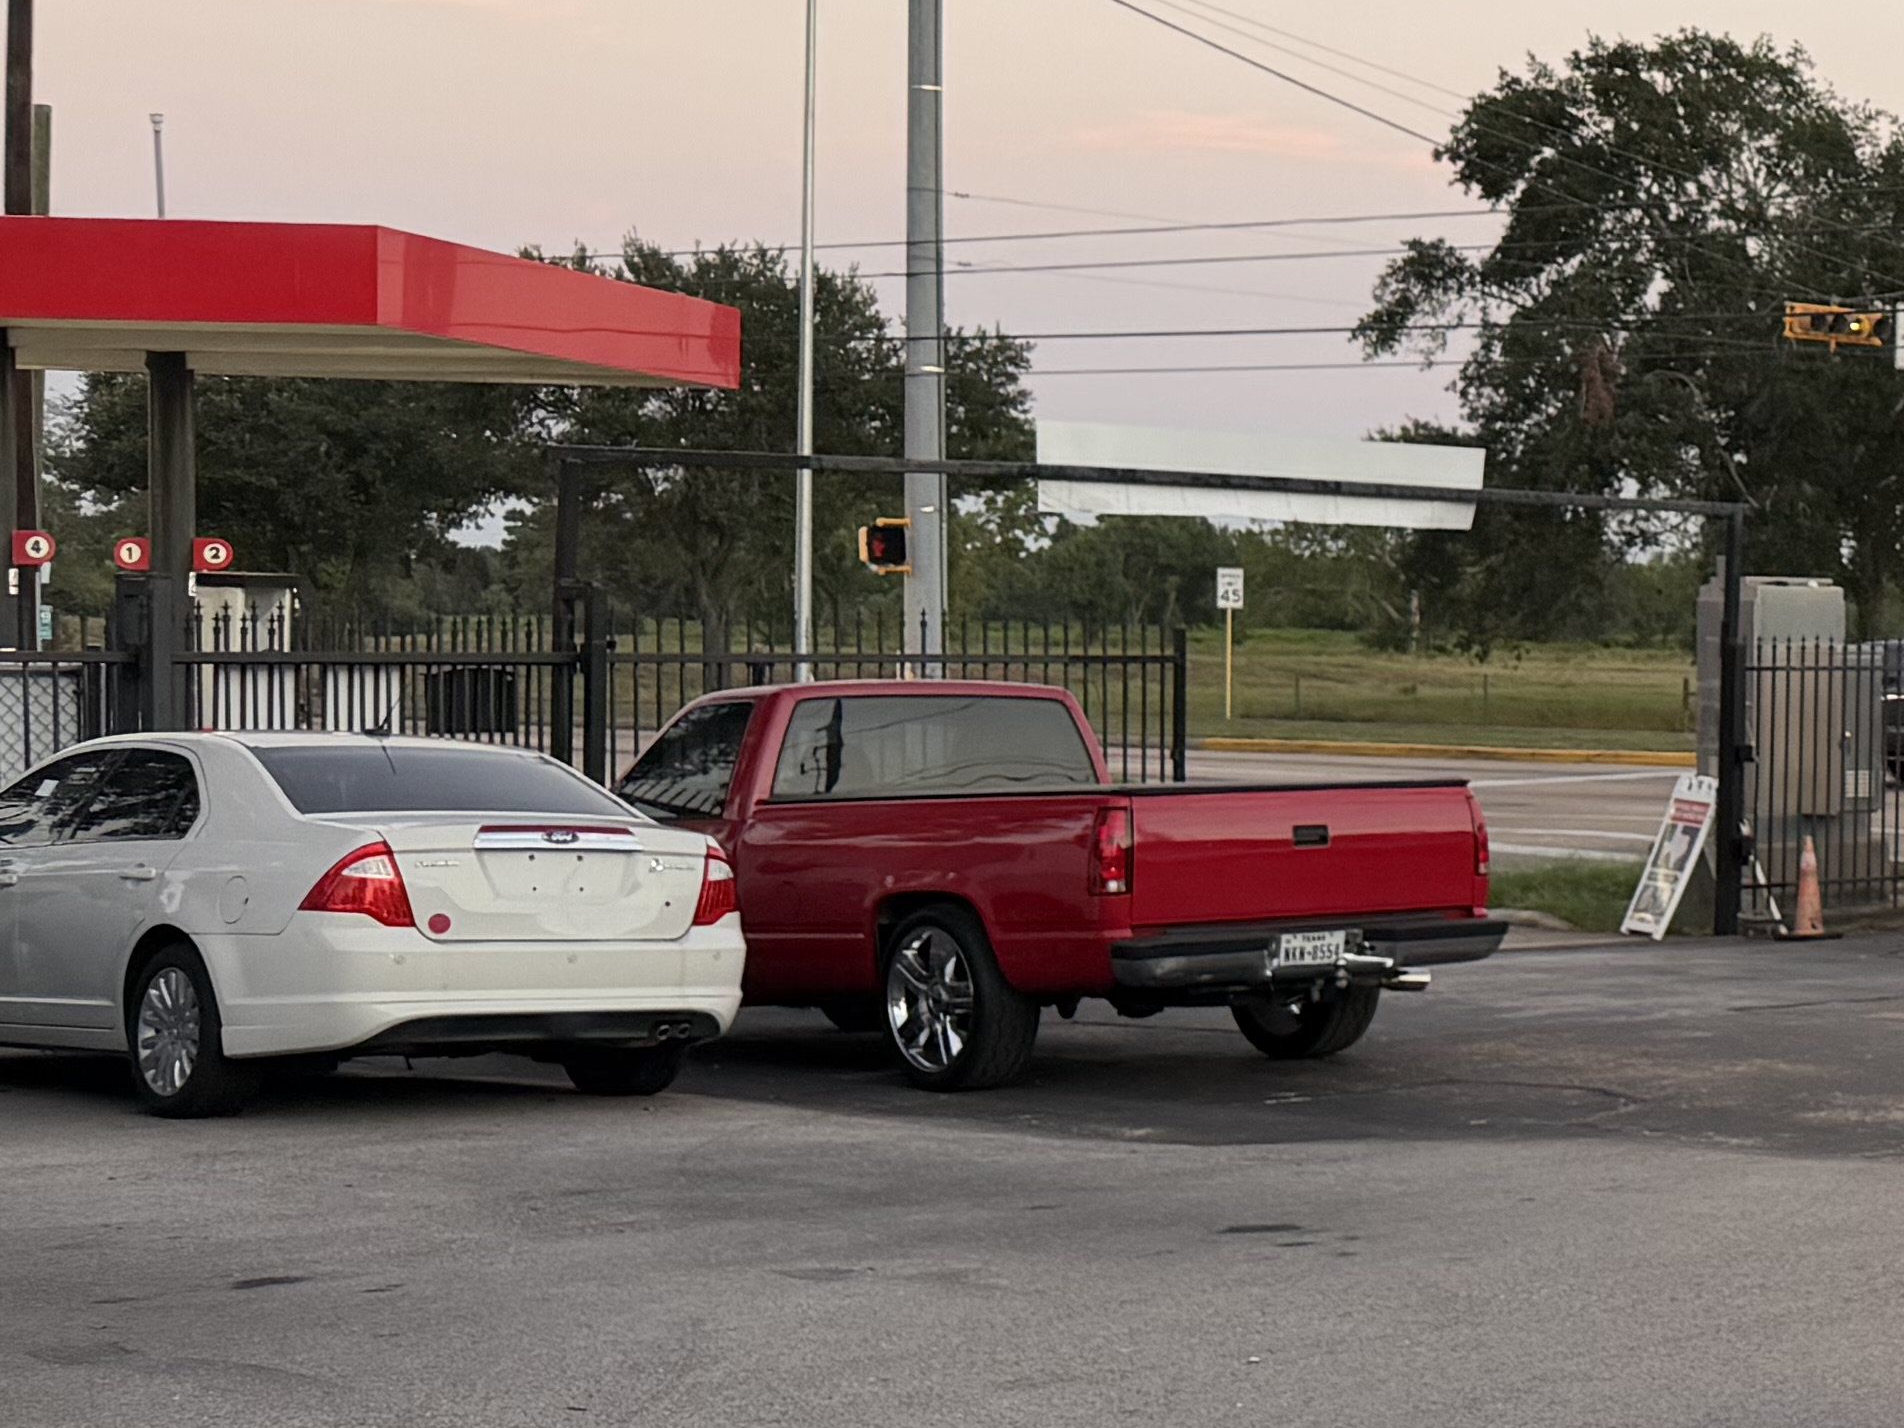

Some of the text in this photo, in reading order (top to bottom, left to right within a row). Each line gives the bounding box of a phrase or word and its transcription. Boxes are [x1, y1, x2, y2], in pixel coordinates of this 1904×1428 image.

[30, 539, 42, 554] 4
[125, 546, 134, 560] 1
[208, 546, 221, 560] 2
[1220, 588, 1241, 603] 45
